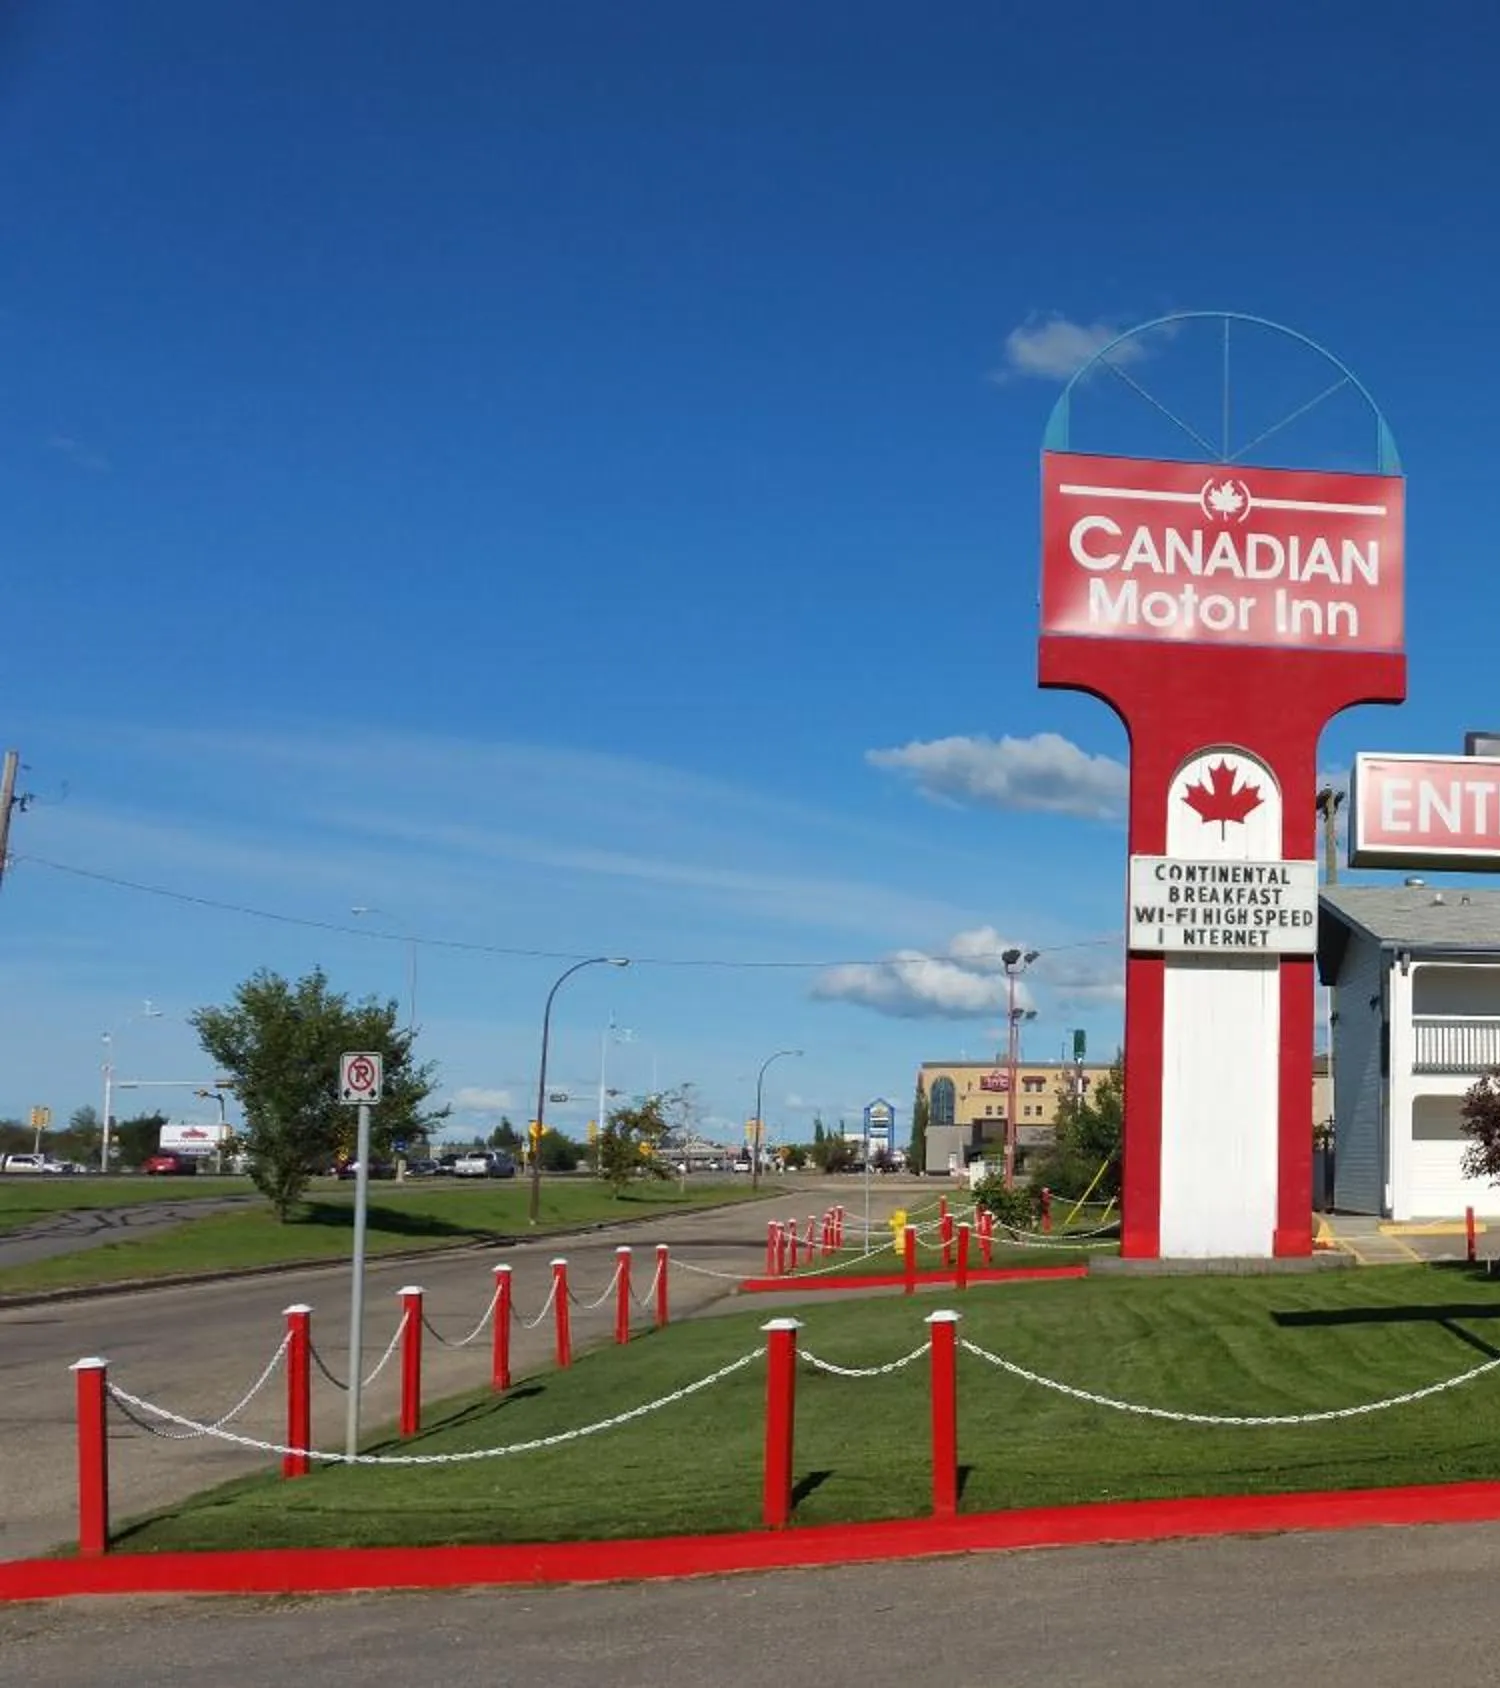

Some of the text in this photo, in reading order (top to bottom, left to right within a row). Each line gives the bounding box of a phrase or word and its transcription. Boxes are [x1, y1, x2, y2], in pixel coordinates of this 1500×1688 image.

[1069, 515, 1378, 585] CANADIAN
[1088, 578, 1359, 636] Motor Inn
[1155, 864, 1291, 884] CONTINENTAL
[1169, 886, 1283, 905] BREAKFAST
[1134, 906, 1313, 926] WI-FI HIGH SPEED
